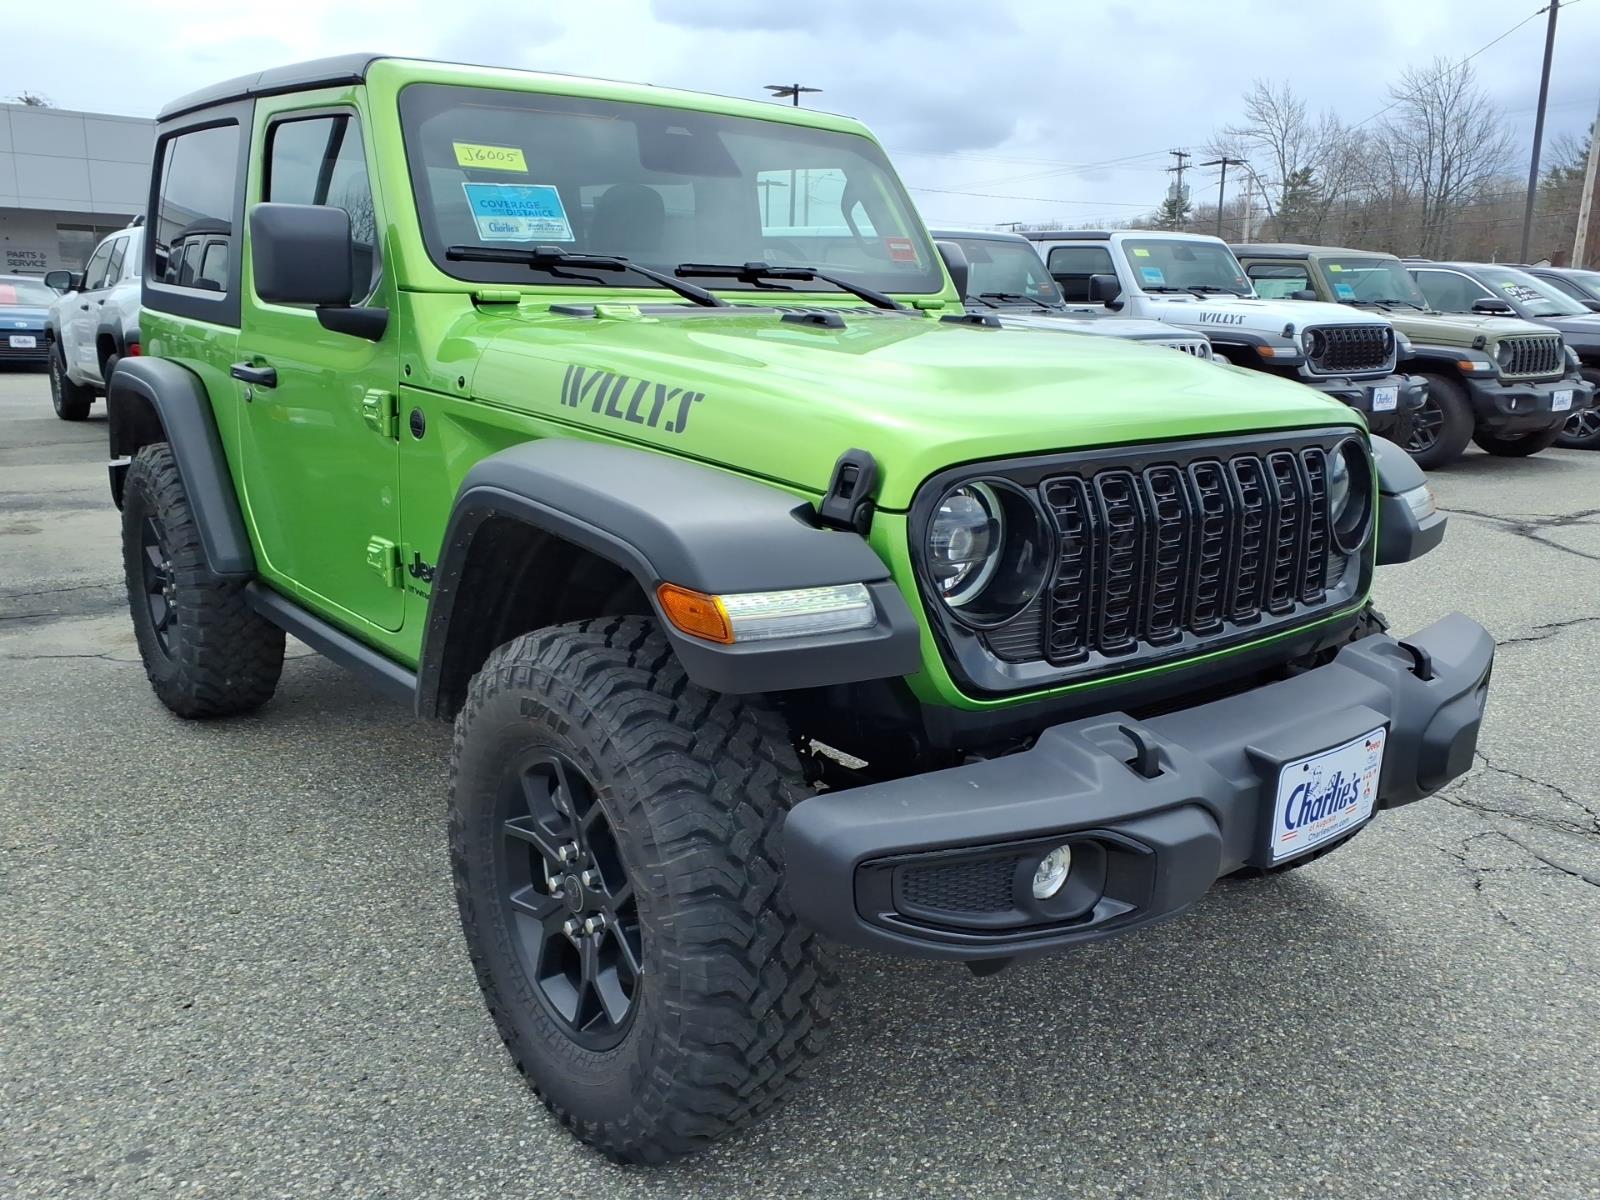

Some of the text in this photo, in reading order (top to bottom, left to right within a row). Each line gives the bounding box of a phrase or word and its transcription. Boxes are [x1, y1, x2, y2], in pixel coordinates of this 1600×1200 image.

[464, 146, 518, 163] J6005
[479, 199, 541, 209] COVERAGE
[506, 208, 554, 217] DISTANCE
[488, 222, 520, 233] Charlie's
[6, 251, 37, 259] PARTS
[7, 259, 47, 267] SERVICE
[1199, 312, 1247, 325] WILLYS
[560, 364, 706, 434] WILLYS
[1284, 771, 1361, 830] Charlie's
